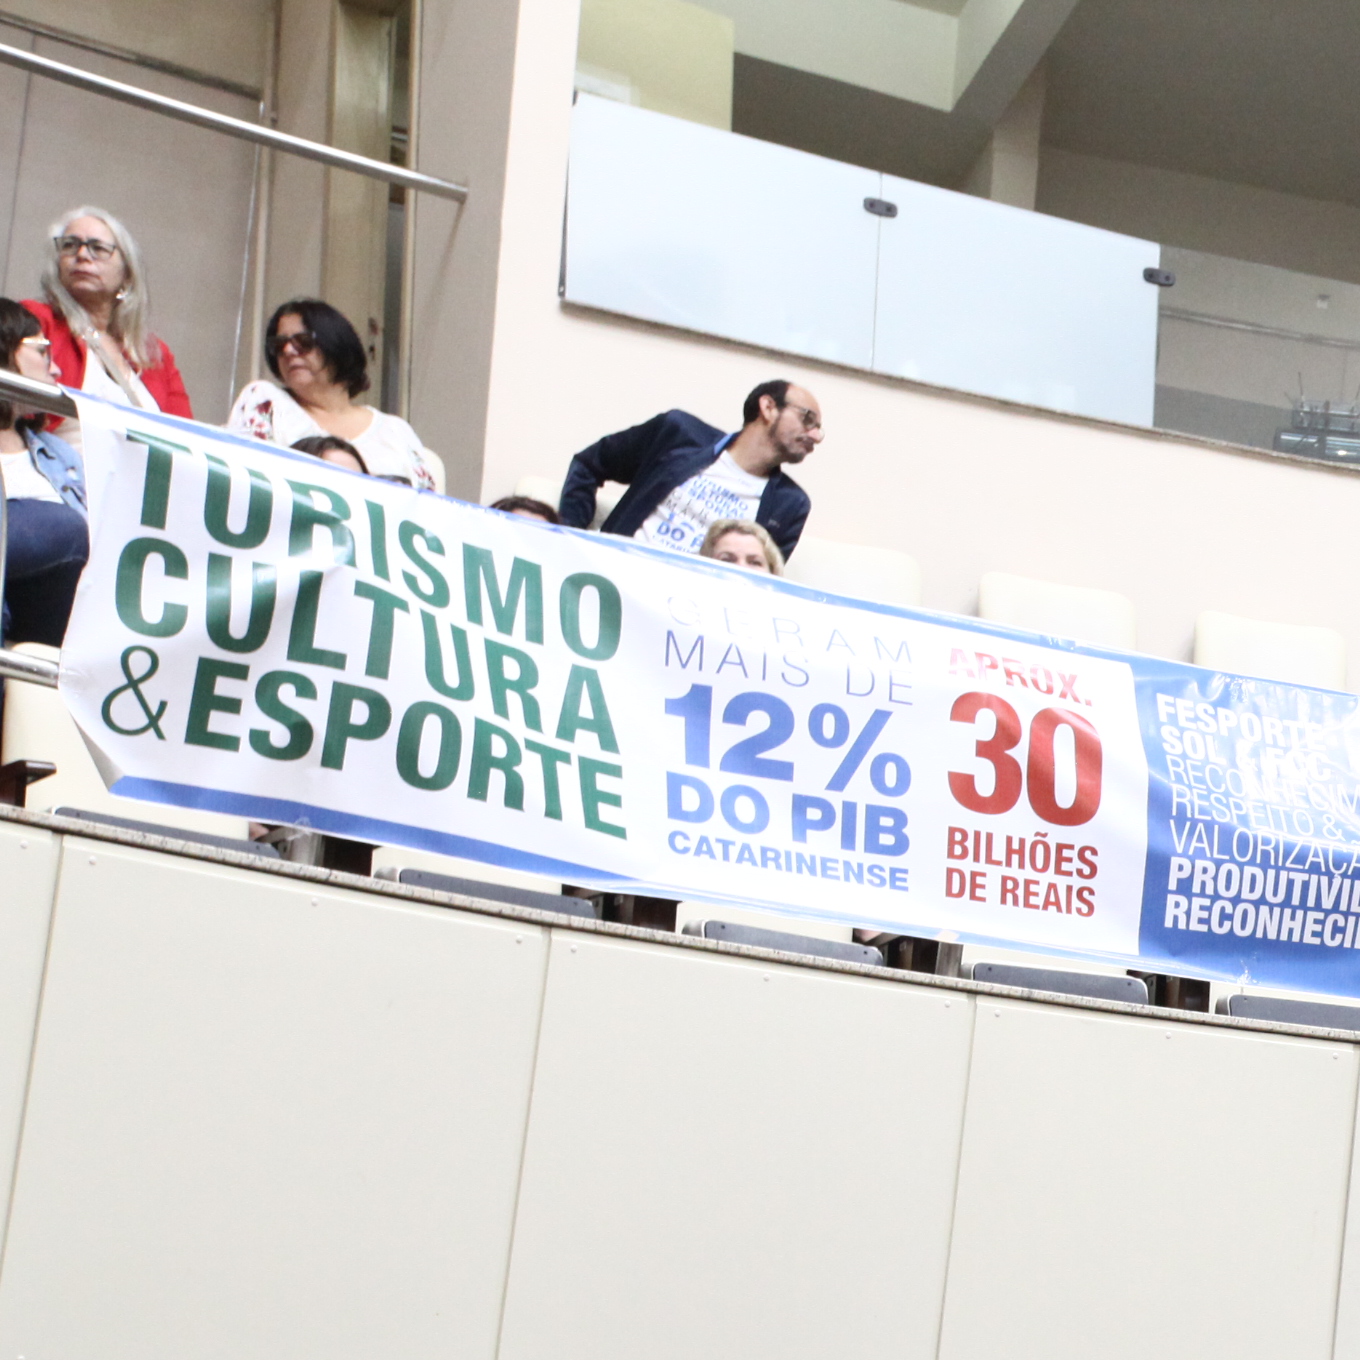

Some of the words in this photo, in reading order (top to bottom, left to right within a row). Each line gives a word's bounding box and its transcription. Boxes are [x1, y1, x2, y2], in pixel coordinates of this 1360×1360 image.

[126, 428, 622, 661] TURISMO
[657, 521, 685, 541] DO
[115, 537, 620, 755] CULTURA
[666, 596, 912, 664] GERAM
[664, 629, 810, 688] MAIS
[846, 662, 914, 706] DE
[948, 648, 1093, 707] APROX.
[664, 683, 913, 797] 12%
[947, 691, 1103, 827] 30
[1160, 725, 1227, 766] SOL
[666, 770, 770, 835] DO
[791, 793, 910, 856] PIB
[1171, 783, 1315, 837] RESPEITO
[1322, 814, 1346, 842] &
[668, 830, 910, 893] CATARINENSE
[946, 825, 1099, 881] BILHÕES
[945, 866, 988, 903] DE
[1000, 874, 1096, 918] REAIS
